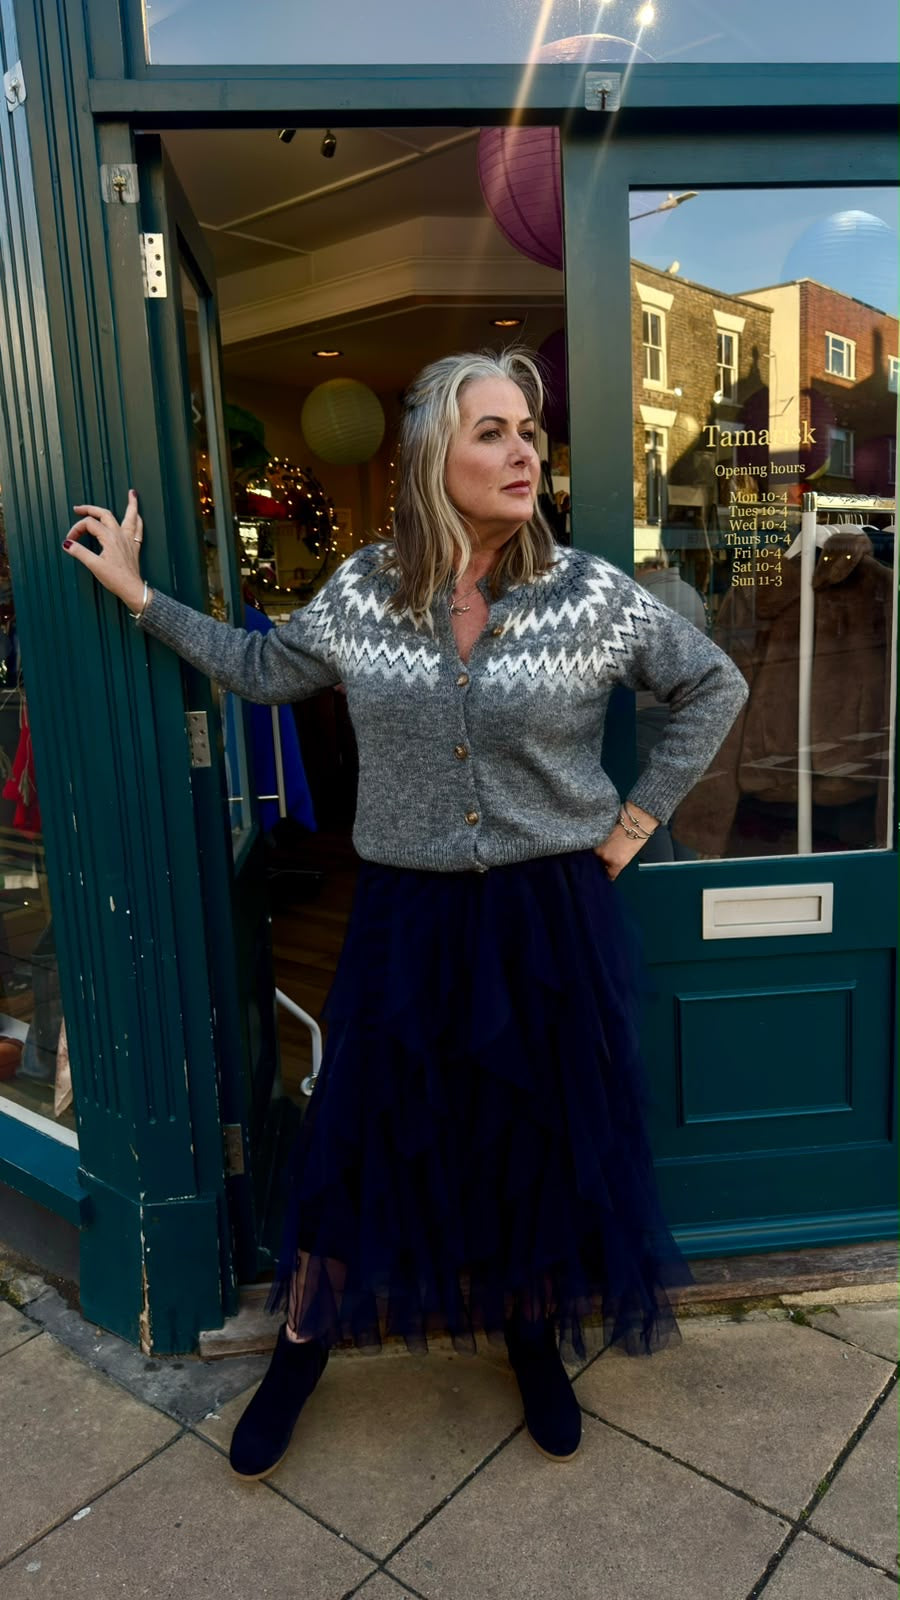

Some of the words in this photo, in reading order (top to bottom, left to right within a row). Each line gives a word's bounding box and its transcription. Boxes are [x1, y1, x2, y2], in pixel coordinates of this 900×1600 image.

[702, 420, 817, 448] Tamarisk
[715, 463, 768, 479] Opening
[770, 461, 806, 474] hours
[730, 491, 758, 503] Mon
[761, 491, 788, 504] 10-4
[728, 505, 758, 518] Tues
[761, 505, 788, 517] 10-4
[729, 518, 757, 531] Wed
[761, 519, 787, 531] 10-4
[724, 532, 761, 546] Thurs
[764, 533, 792, 545] 10-4
[734, 547, 752, 559] Fri
[755, 547, 782, 560] 10-4
[732, 561, 752, 573] Sat
[755, 561, 782, 574] 10-4
[731, 575, 755, 587] Sun
[758, 575, 783, 587] 11-3
